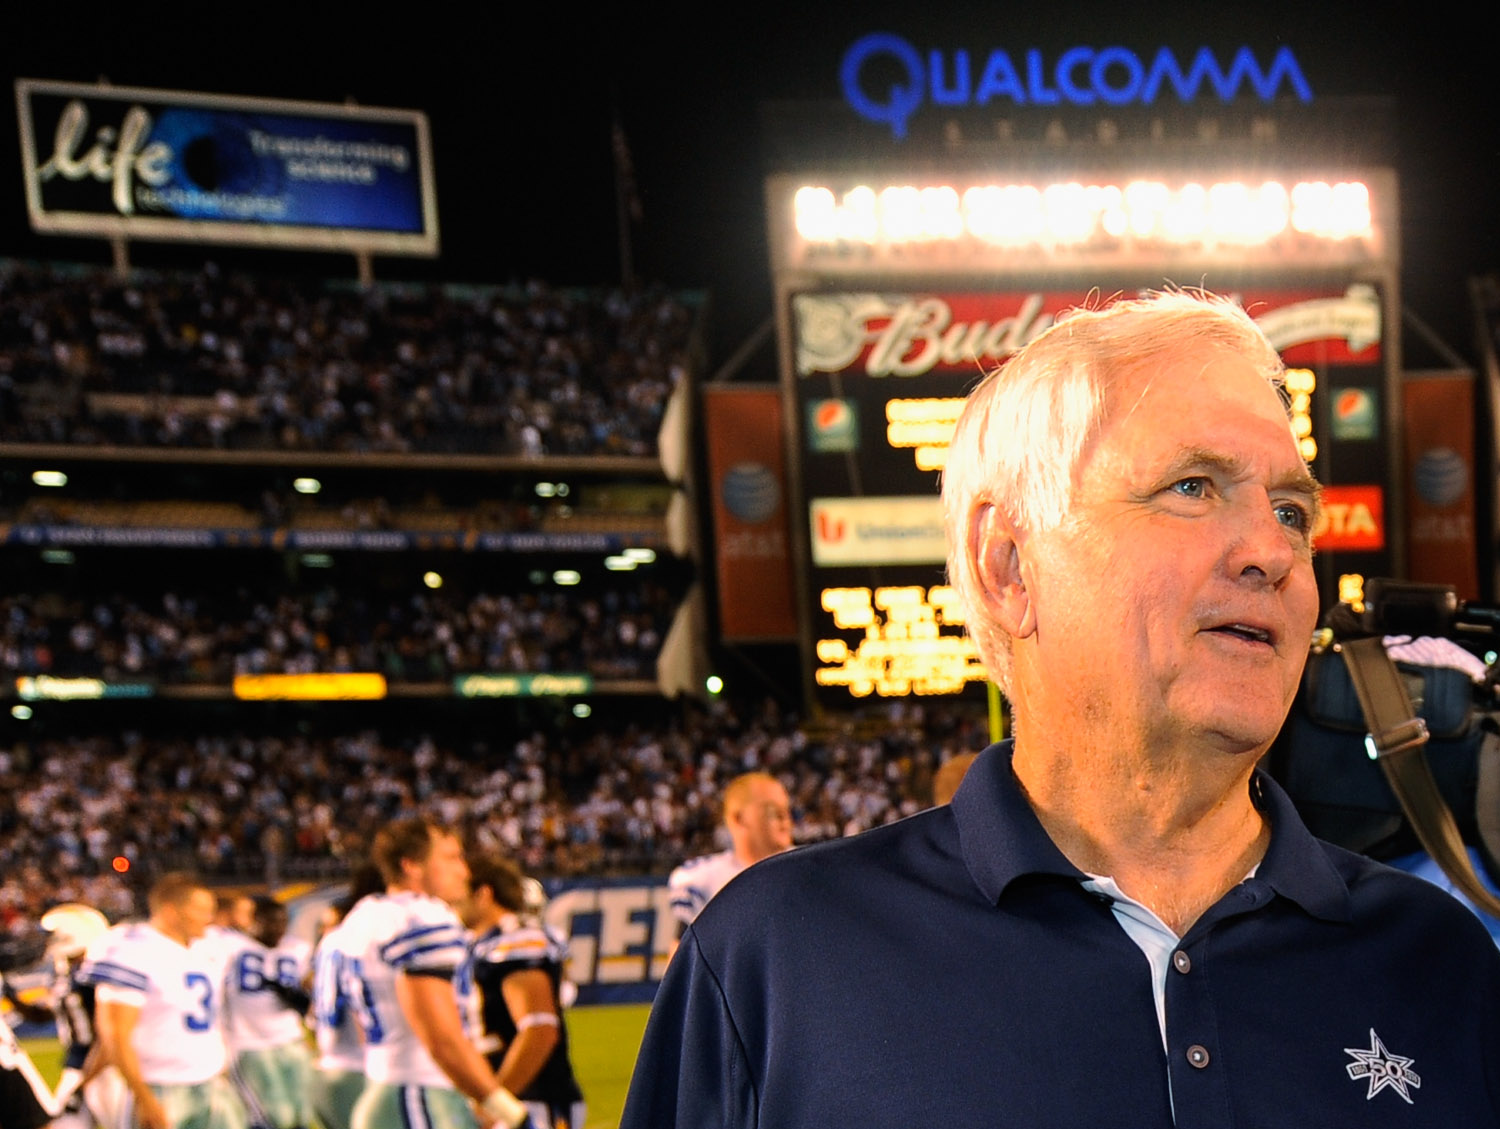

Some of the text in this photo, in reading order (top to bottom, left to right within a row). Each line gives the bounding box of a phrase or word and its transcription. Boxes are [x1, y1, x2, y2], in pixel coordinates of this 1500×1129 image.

[36, 101, 173, 216] life
[184, 972, 213, 1031] 3
[1370, 1058, 1402, 1079] 50
